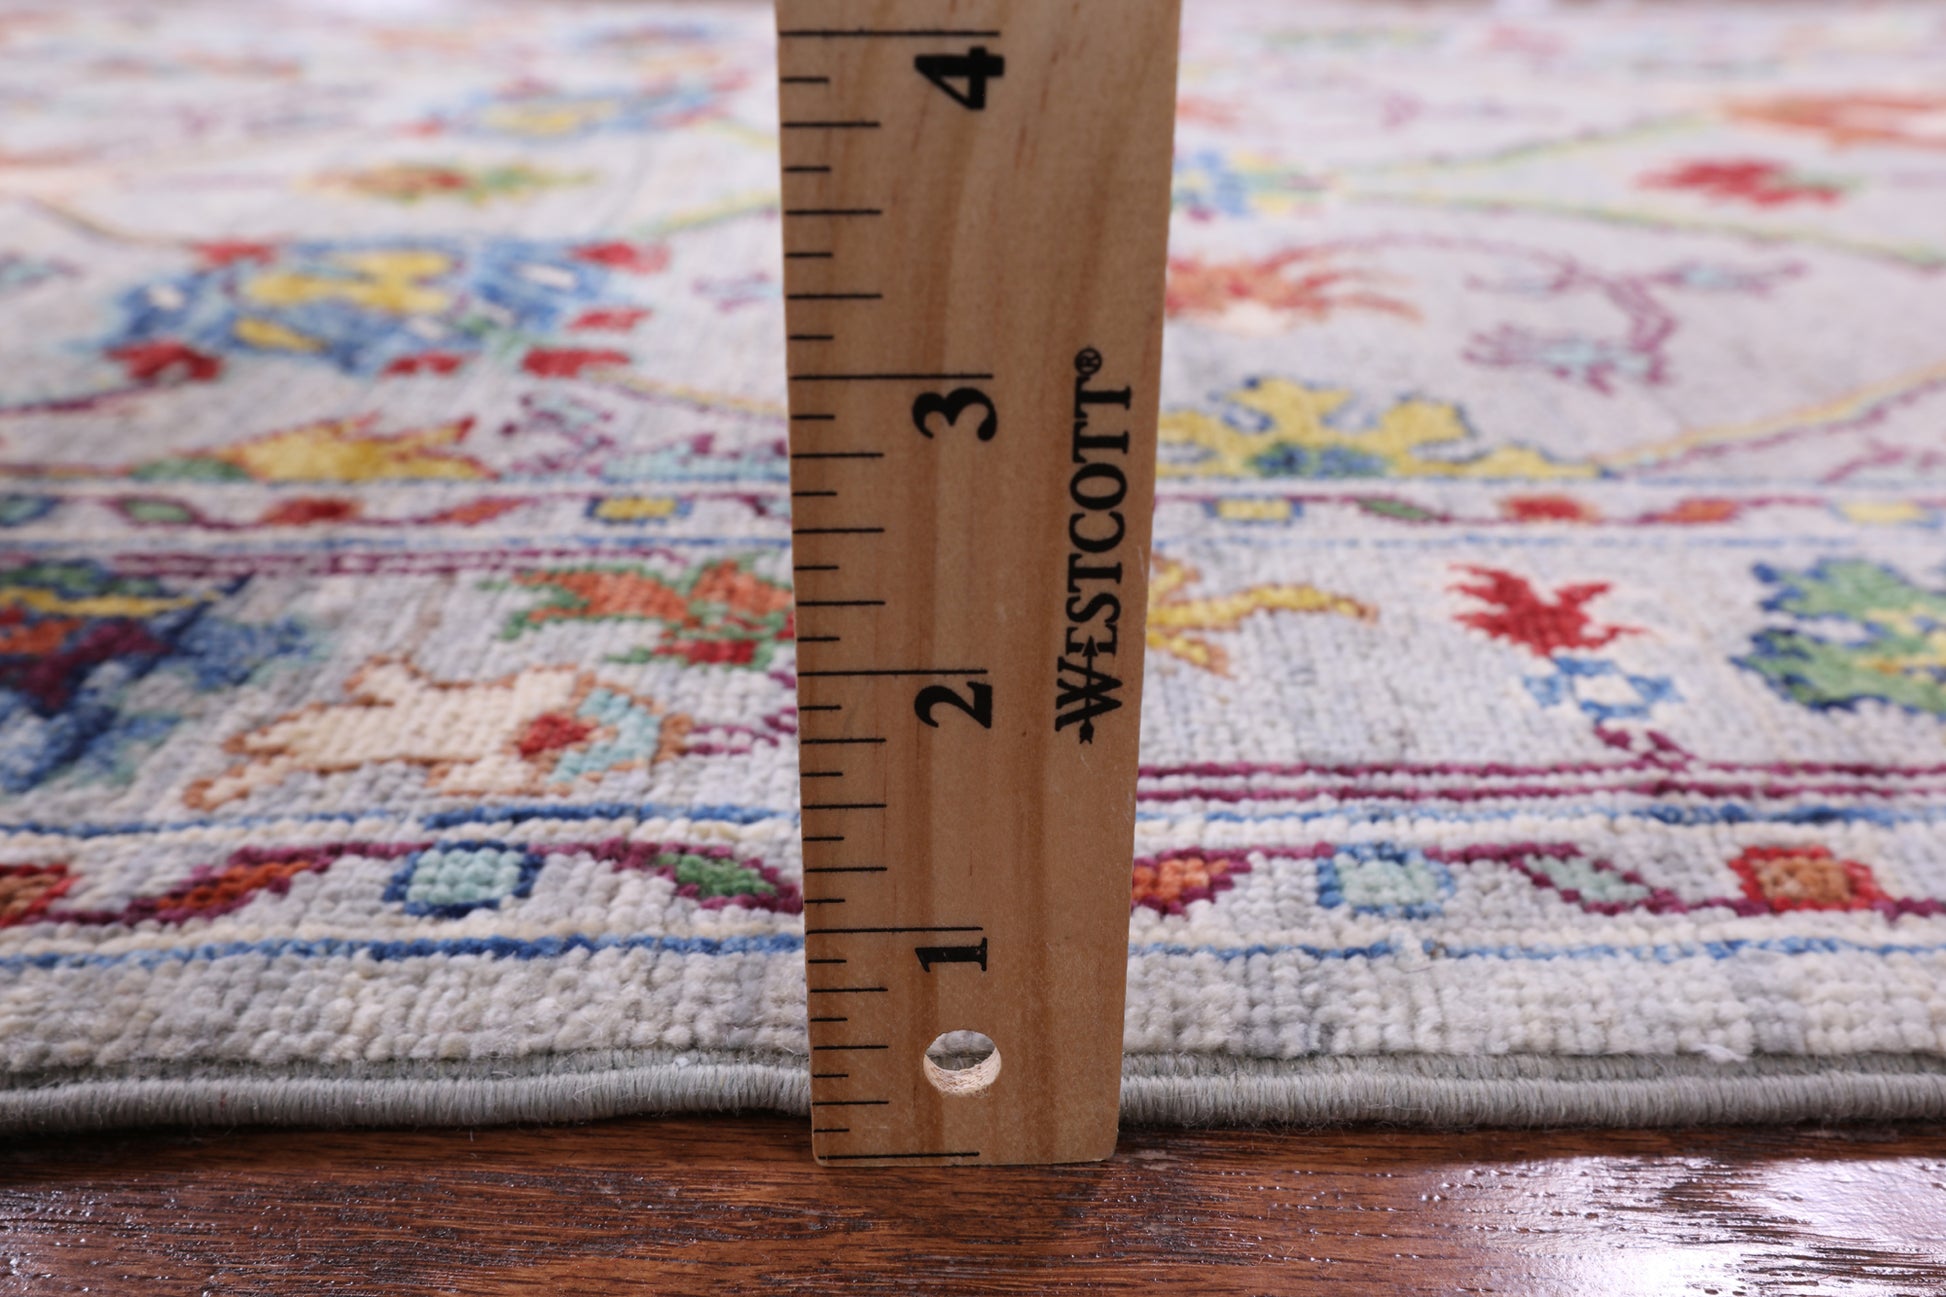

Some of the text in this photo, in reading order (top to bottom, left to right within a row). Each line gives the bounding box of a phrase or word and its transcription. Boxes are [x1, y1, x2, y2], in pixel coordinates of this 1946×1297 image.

[913, 45, 1005, 112] 4
[911, 387, 998, 441] 3
[914, 681, 993, 730] 2
[914, 937, 988, 972] 1
